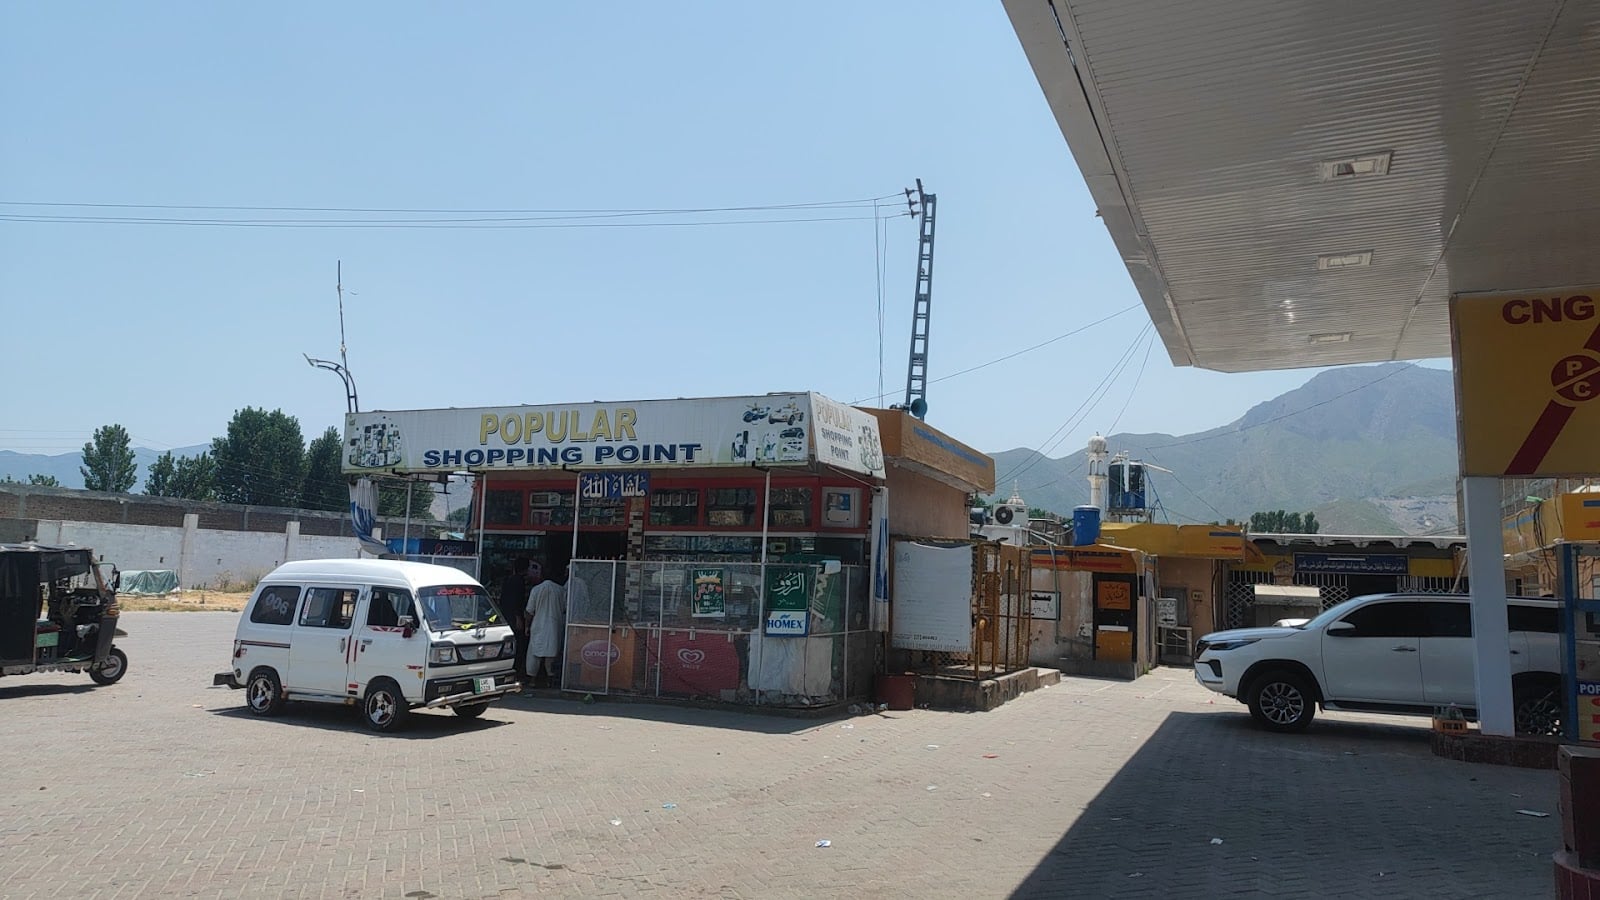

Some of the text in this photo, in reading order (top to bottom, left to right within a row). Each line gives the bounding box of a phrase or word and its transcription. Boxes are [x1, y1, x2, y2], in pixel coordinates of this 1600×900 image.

[1502, 295, 1595, 324] CNG
[1566, 361, 1583, 376] P
[1573, 381, 1591, 397] C
[479, 408, 638, 445] POPULAR
[821, 427, 853, 448] SHOPPING
[423, 443, 702, 467] SHOPPING POINT
[830, 445, 849, 461] POINT
[767, 619, 803, 629] HOMEX
